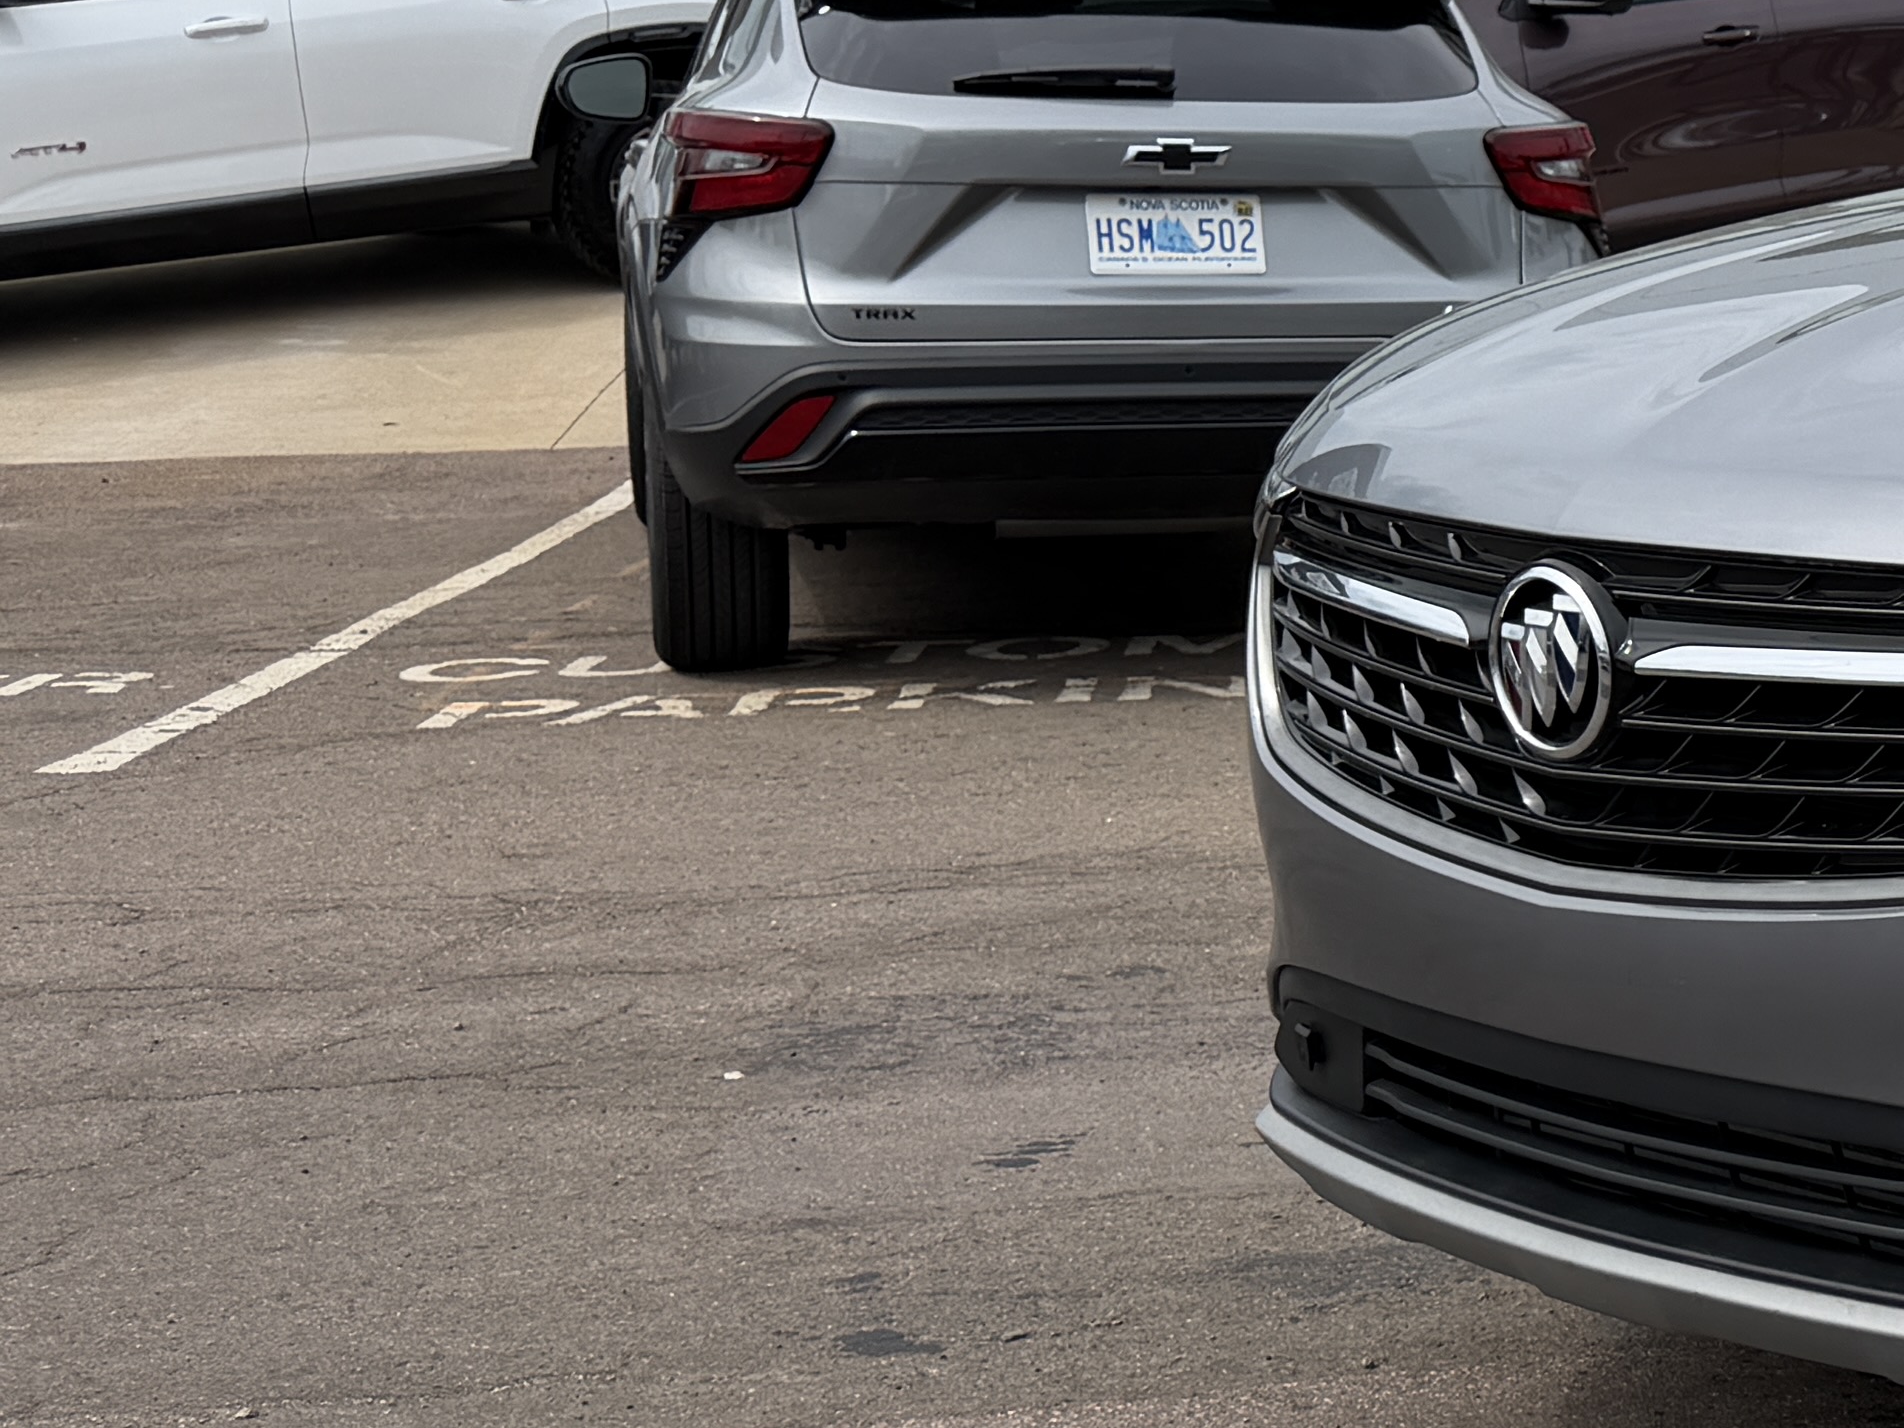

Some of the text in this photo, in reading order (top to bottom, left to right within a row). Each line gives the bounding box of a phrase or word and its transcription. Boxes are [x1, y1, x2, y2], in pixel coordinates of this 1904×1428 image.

[1129, 198, 1219, 211] NOVA SCOTIA
[1096, 218, 1257, 254] HSM 502
